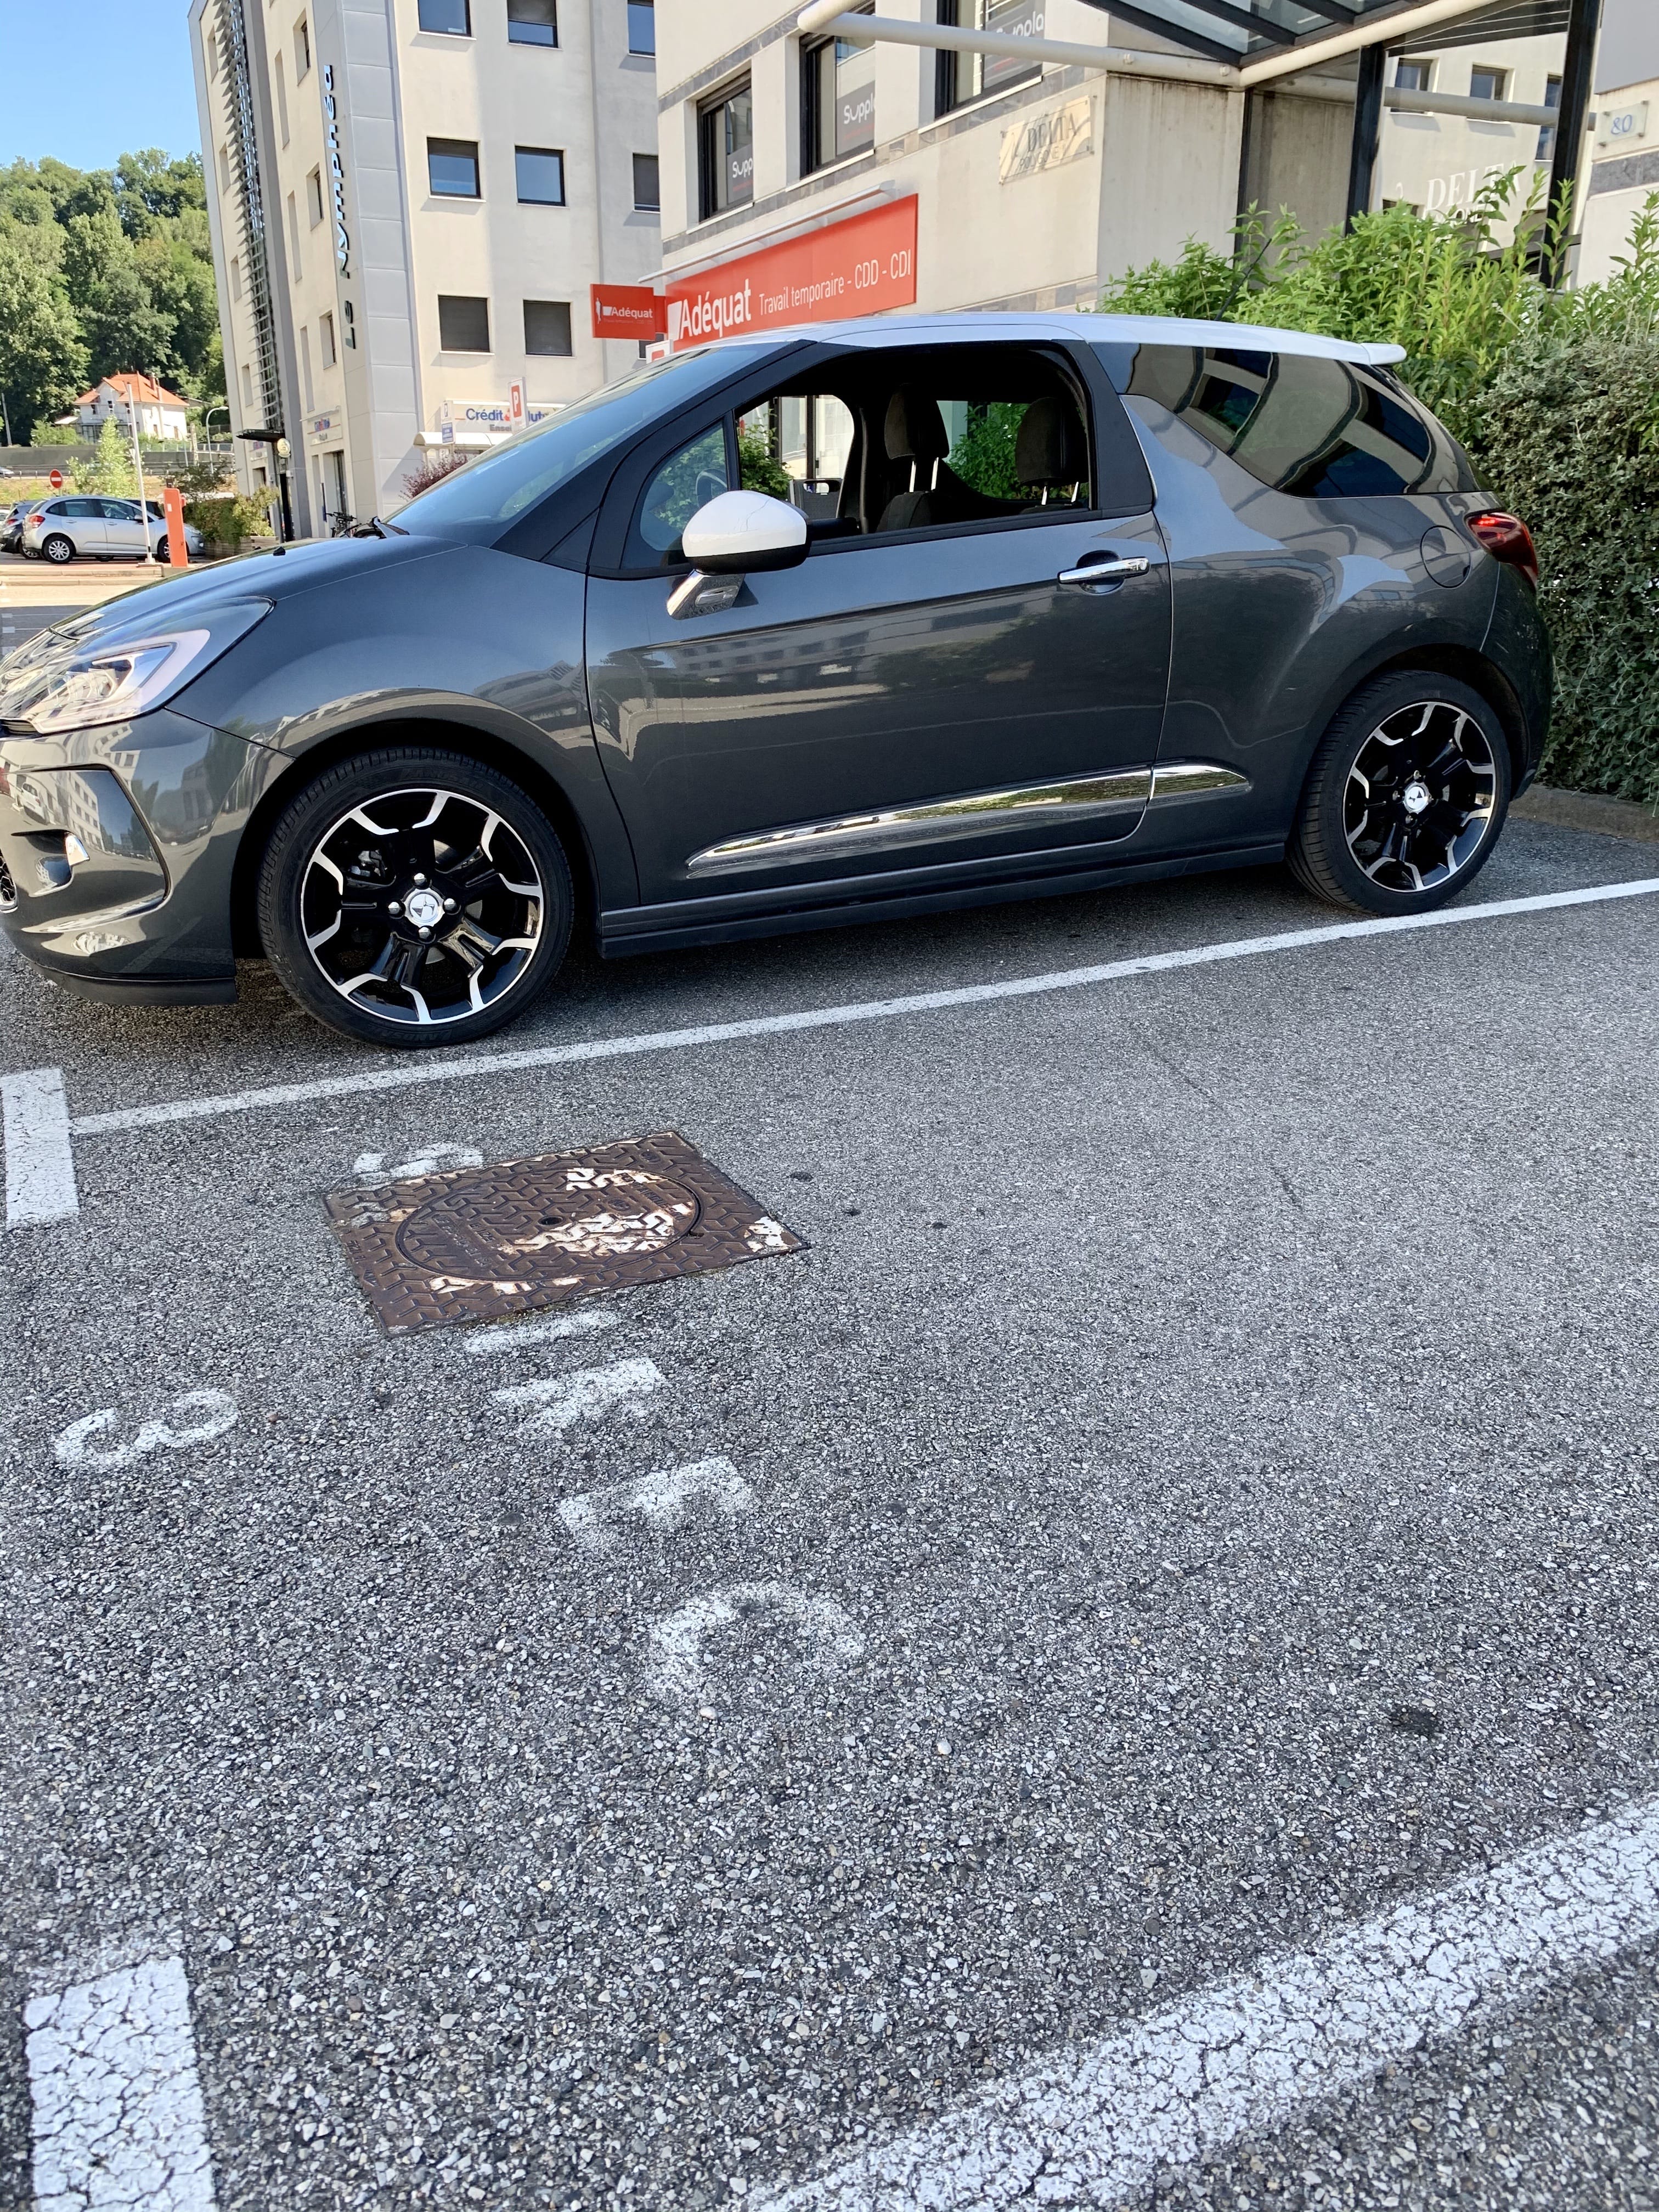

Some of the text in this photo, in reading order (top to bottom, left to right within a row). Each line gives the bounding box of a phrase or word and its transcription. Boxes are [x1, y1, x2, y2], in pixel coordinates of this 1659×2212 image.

[611, 307, 653, 319] Adéquat
[680, 278, 751, 340] Adéquat
[759, 286, 789, 315] Travail
[791, 272, 844, 309] temporaire
[855, 259, 879, 289] CDD
[890, 249, 911, 280] CDI
[466, 408, 503, 421] Crédit
[54, 1388, 240, 1470] 3
